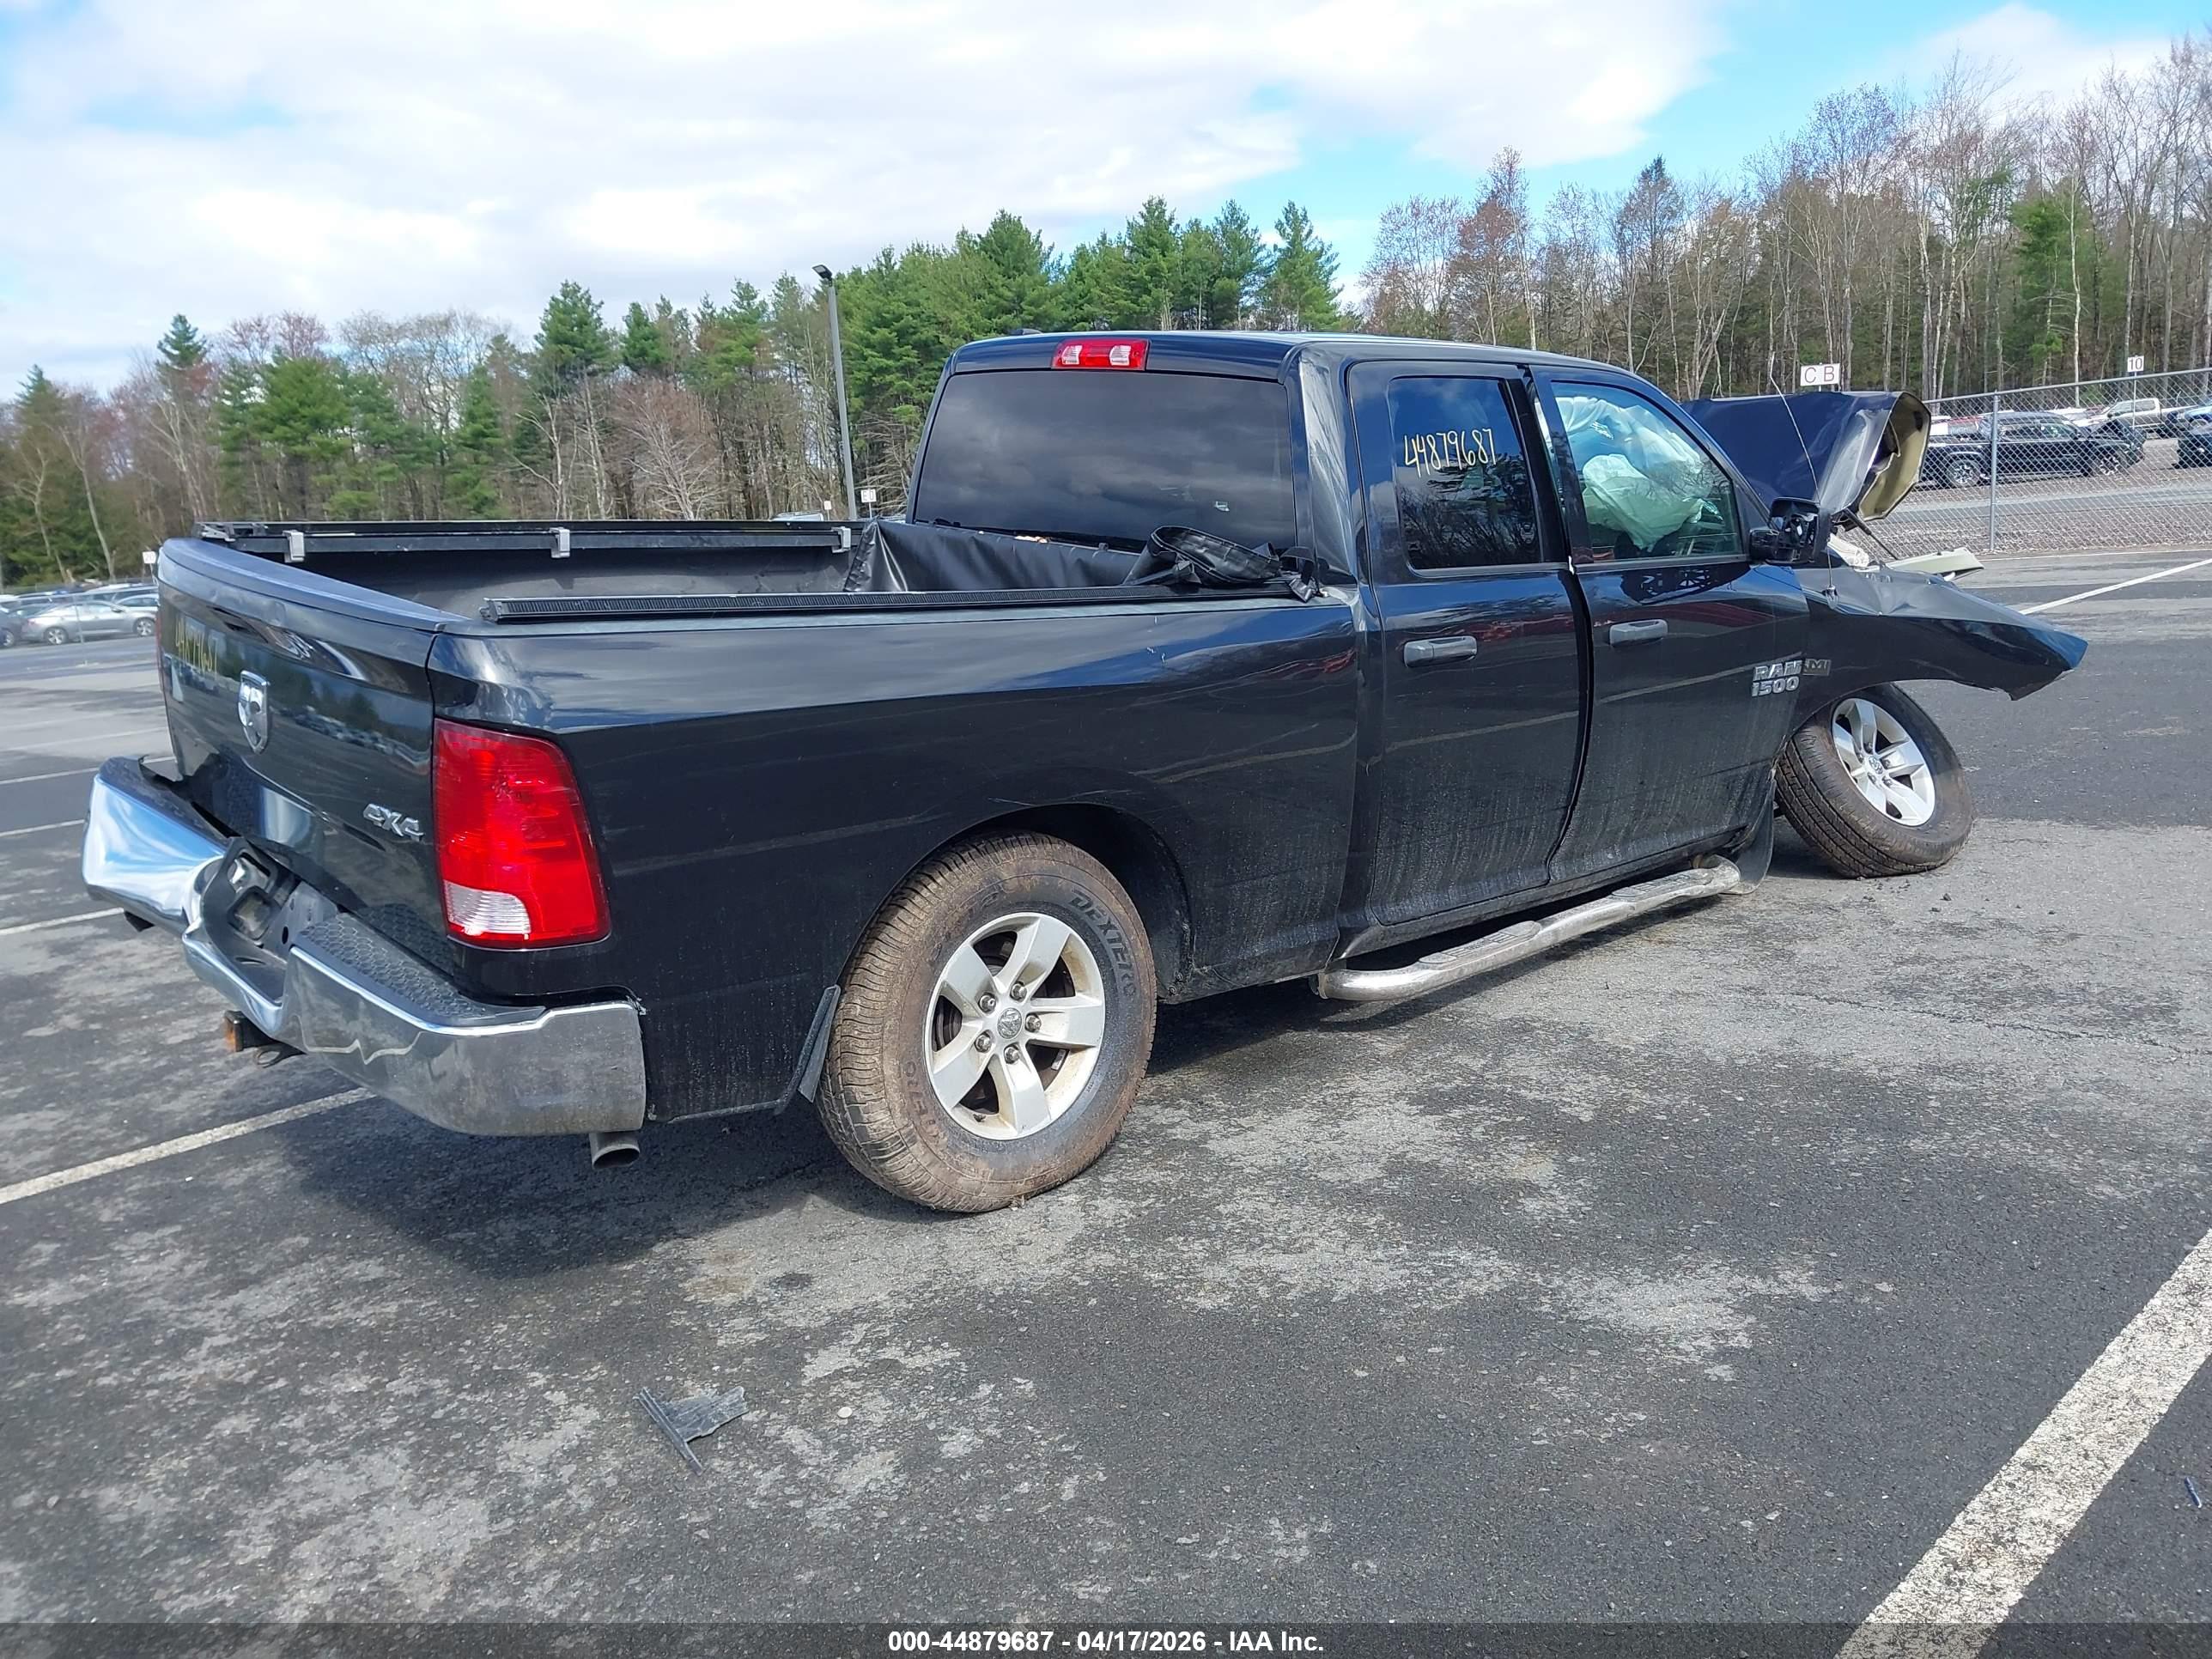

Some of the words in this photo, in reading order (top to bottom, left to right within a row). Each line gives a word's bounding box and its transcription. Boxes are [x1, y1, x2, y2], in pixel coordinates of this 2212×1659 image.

[2129, 357, 2143, 370] 10
[1404, 428, 1497, 478] 44879687
[1753, 659, 1802, 681] RAM
[1751, 676, 1800, 696] 1500
